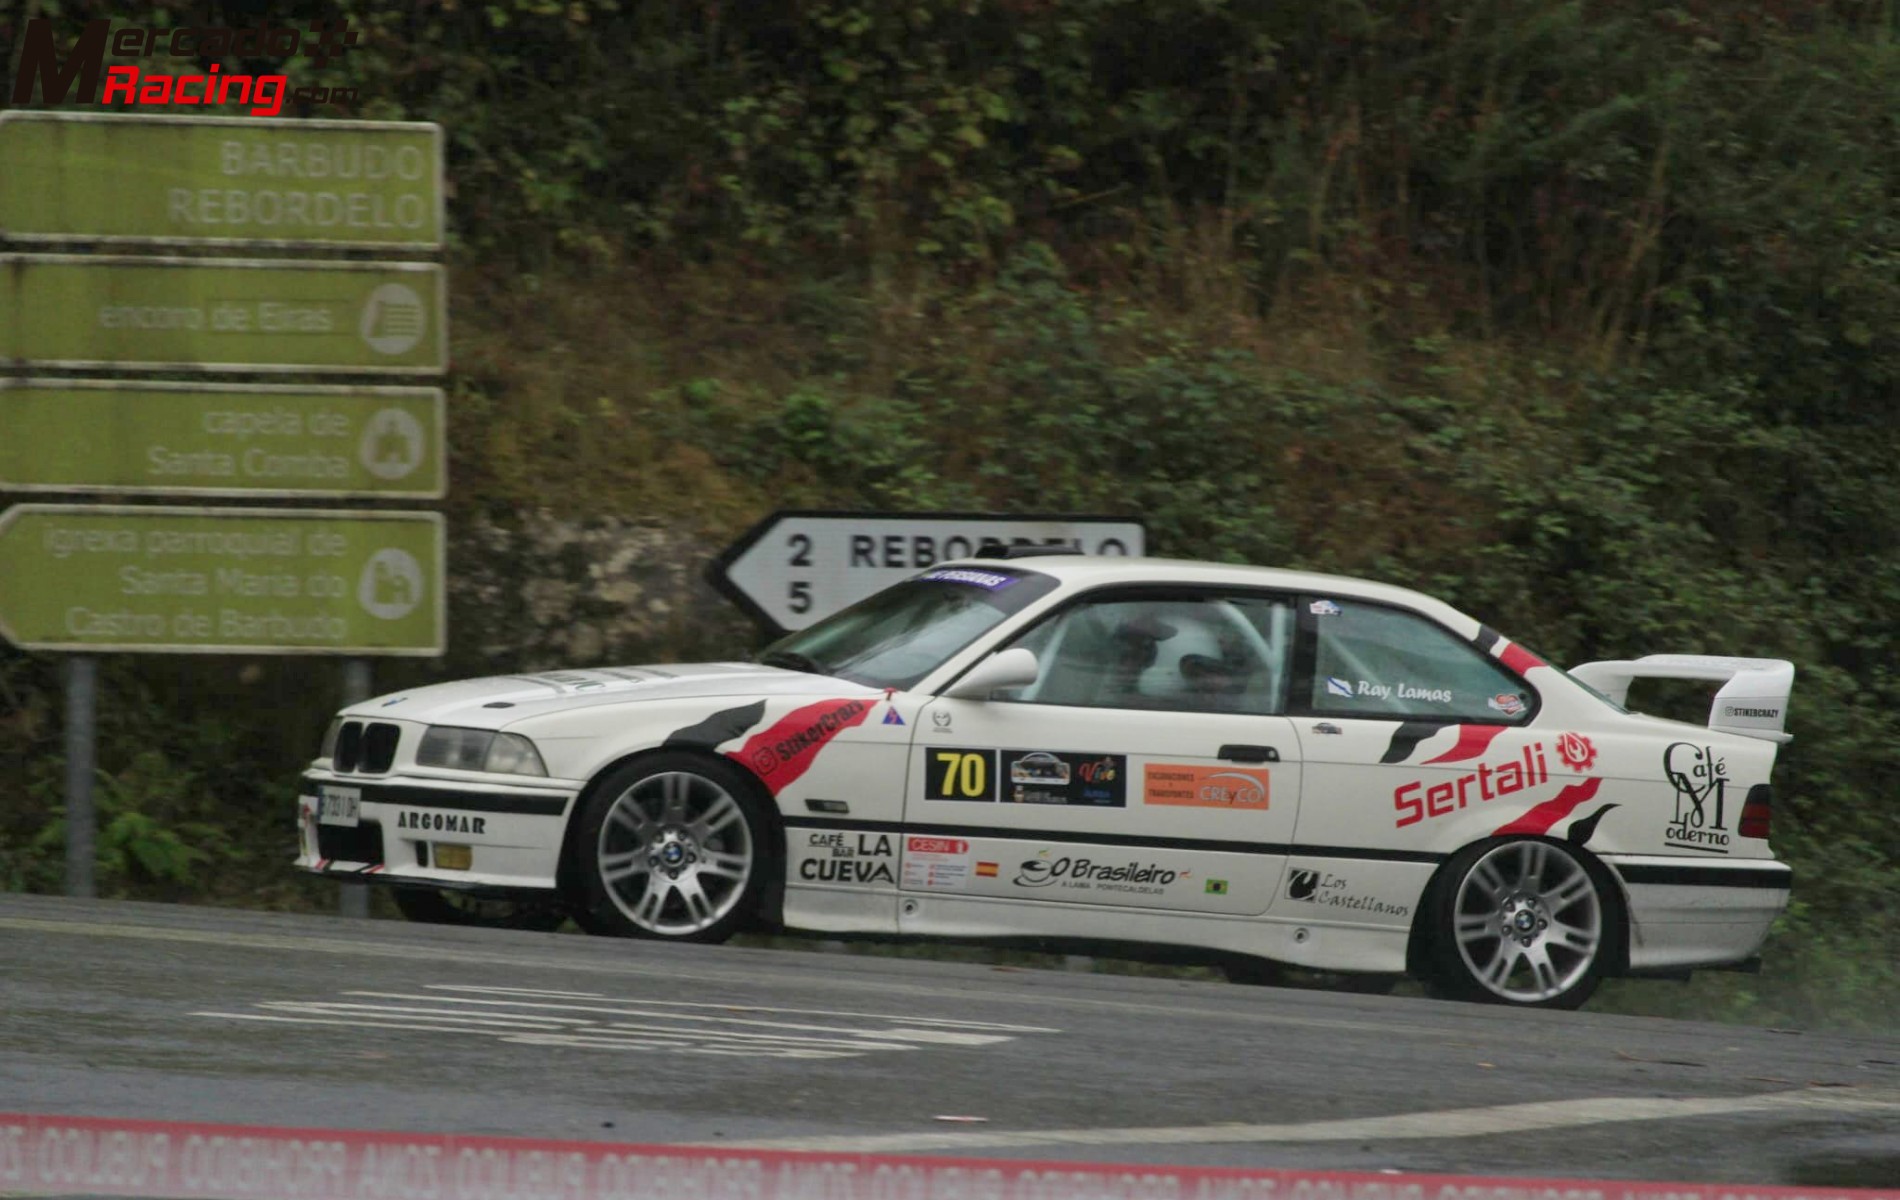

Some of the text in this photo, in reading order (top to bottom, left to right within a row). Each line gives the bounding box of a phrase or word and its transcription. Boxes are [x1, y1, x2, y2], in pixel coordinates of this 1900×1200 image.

[221, 141, 422, 181] BARBUDO
[168, 188, 424, 229] REBORDELO
[211, 302, 247, 331] de
[204, 407, 349, 442] capela de
[148, 446, 349, 479] Santa Comba
[308, 528, 346, 556] de
[788, 534, 812, 567] 2
[119, 565, 207, 595] Santa
[788, 582, 812, 614] 5
[65, 606, 347, 640] Castro de Barbudo
[1358, 680, 1452, 703] Ray Lamas
[937, 753, 985, 797] 70
[1394, 742, 1548, 828] Sertali
[398, 811, 485, 834] ARGOMAR
[809, 833, 844, 848] CAFÉ
[858, 834, 892, 857] LA
[800, 858, 895, 884] CUEVA
[1072, 859, 1175, 885] Brasileiro
[1321, 873, 1347, 889] Los
[1318, 891, 1409, 917] Castellanos
